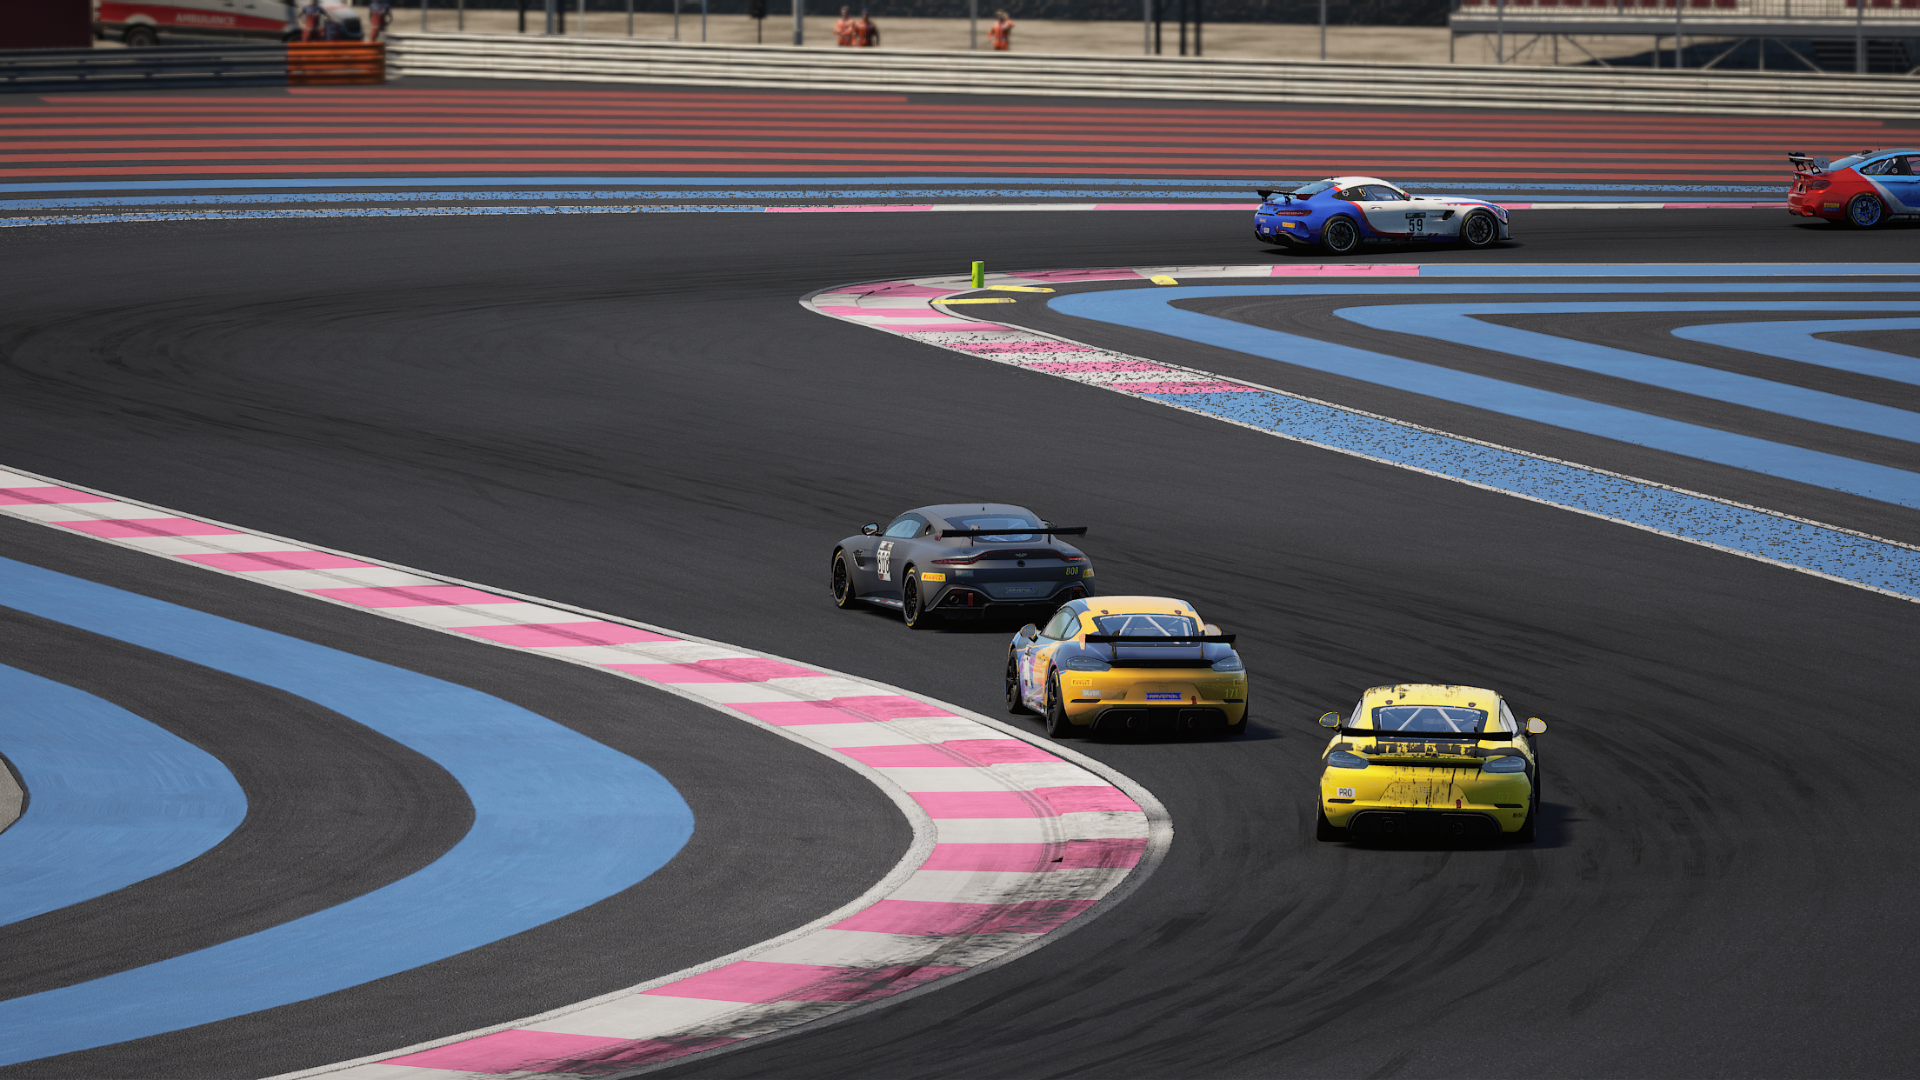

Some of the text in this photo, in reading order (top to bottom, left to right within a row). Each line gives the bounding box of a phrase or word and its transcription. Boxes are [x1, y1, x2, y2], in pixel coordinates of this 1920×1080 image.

[176, 12, 236, 26] AMBULANCE
[1408, 218, 1423, 232] 59
[1065, 566, 1079, 576] 808
[1082, 689, 1100, 697] SILVER
[1338, 787, 1353, 798] PRO
[1498, 792, 1511, 803] 57
